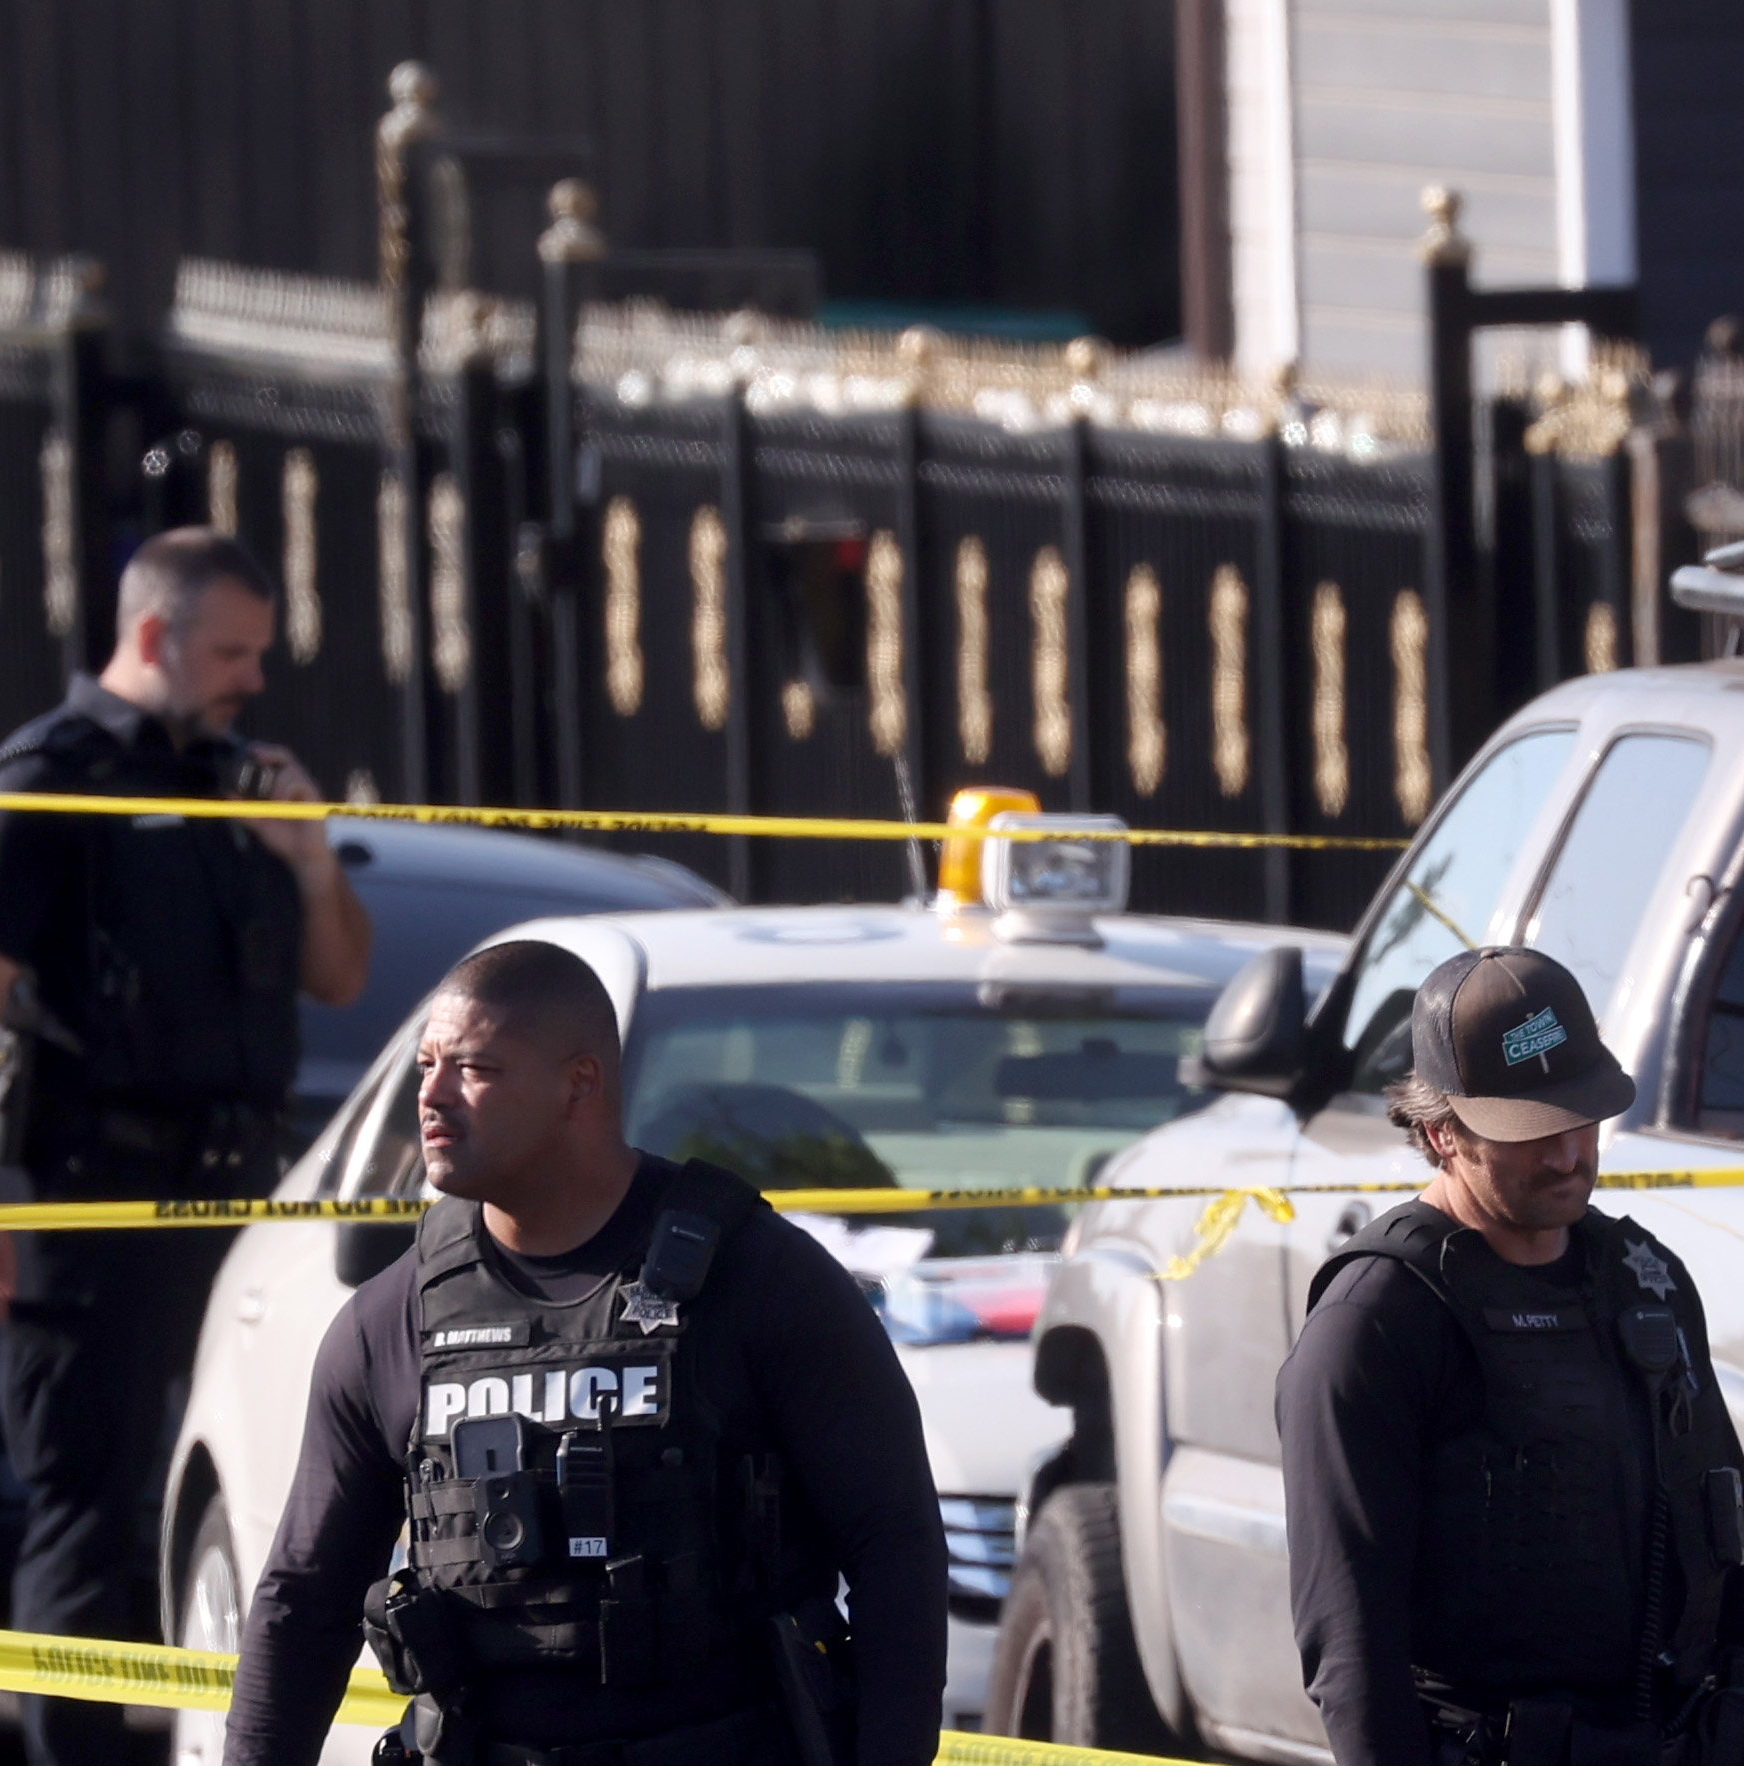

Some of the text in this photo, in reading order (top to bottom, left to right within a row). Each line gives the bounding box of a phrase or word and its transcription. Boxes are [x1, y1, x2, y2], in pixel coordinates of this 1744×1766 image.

[1509, 1029, 1564, 1058] CEASEFIRE
[383, 1197, 433, 1215] INE
[446, 1327, 512, 1345] MATTHEWS
[426, 1366, 658, 1436] POLICE
[573, 1539, 603, 1555] #17
